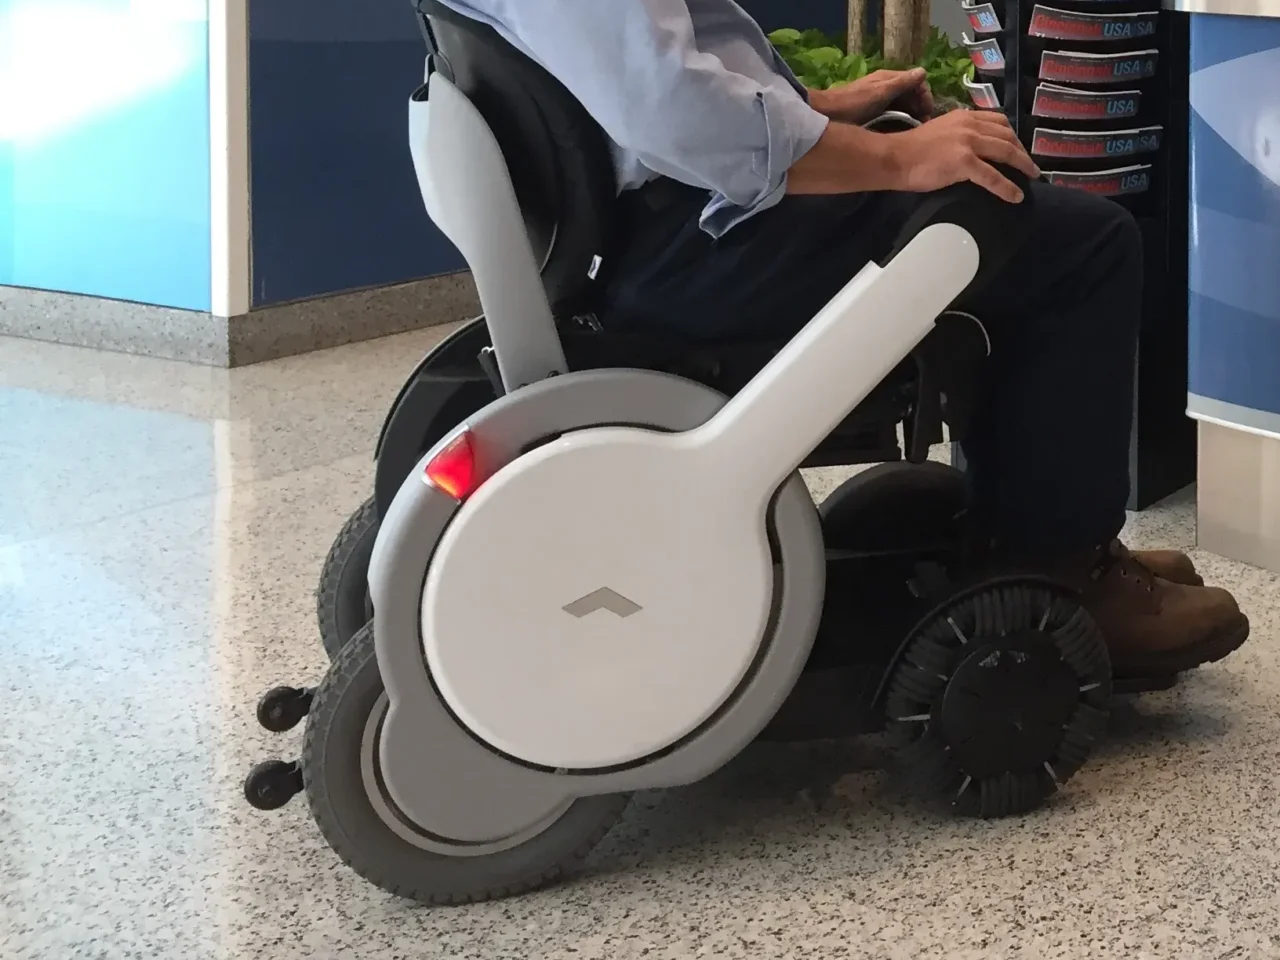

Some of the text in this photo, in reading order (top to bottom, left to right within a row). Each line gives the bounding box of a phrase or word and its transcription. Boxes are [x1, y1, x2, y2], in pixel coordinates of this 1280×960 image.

[977, 11, 994, 27] USA
[1103, 23, 1132, 37] USA
[982, 47, 999, 63] USA
[1113, 60, 1141, 76] USA
[1107, 100, 1135, 113] USA
[1106, 139, 1134, 153] USA
[1121, 173, 1147, 189] USA
